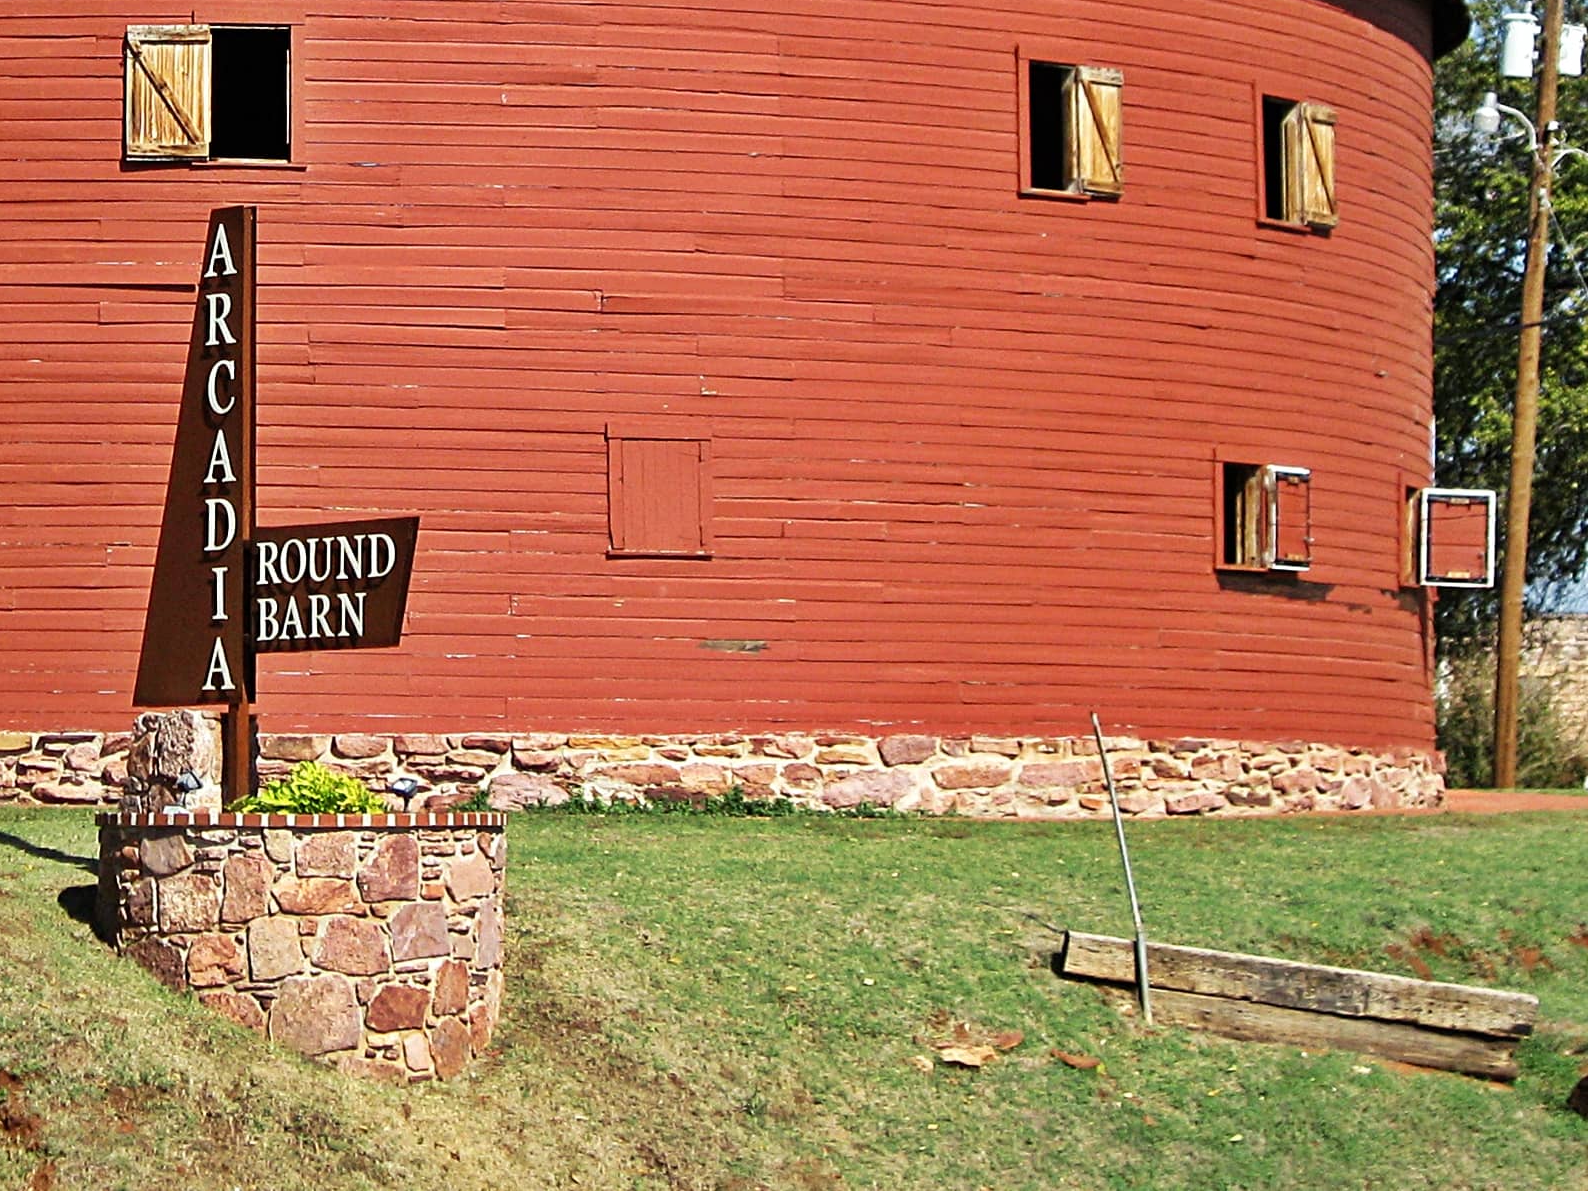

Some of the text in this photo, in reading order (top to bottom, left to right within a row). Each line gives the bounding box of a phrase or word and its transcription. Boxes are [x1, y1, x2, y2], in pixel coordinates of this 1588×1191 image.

[202, 223, 237, 691] ARCADIA
[256, 533, 396, 586] ROUND
[256, 592, 367, 642] BARN
